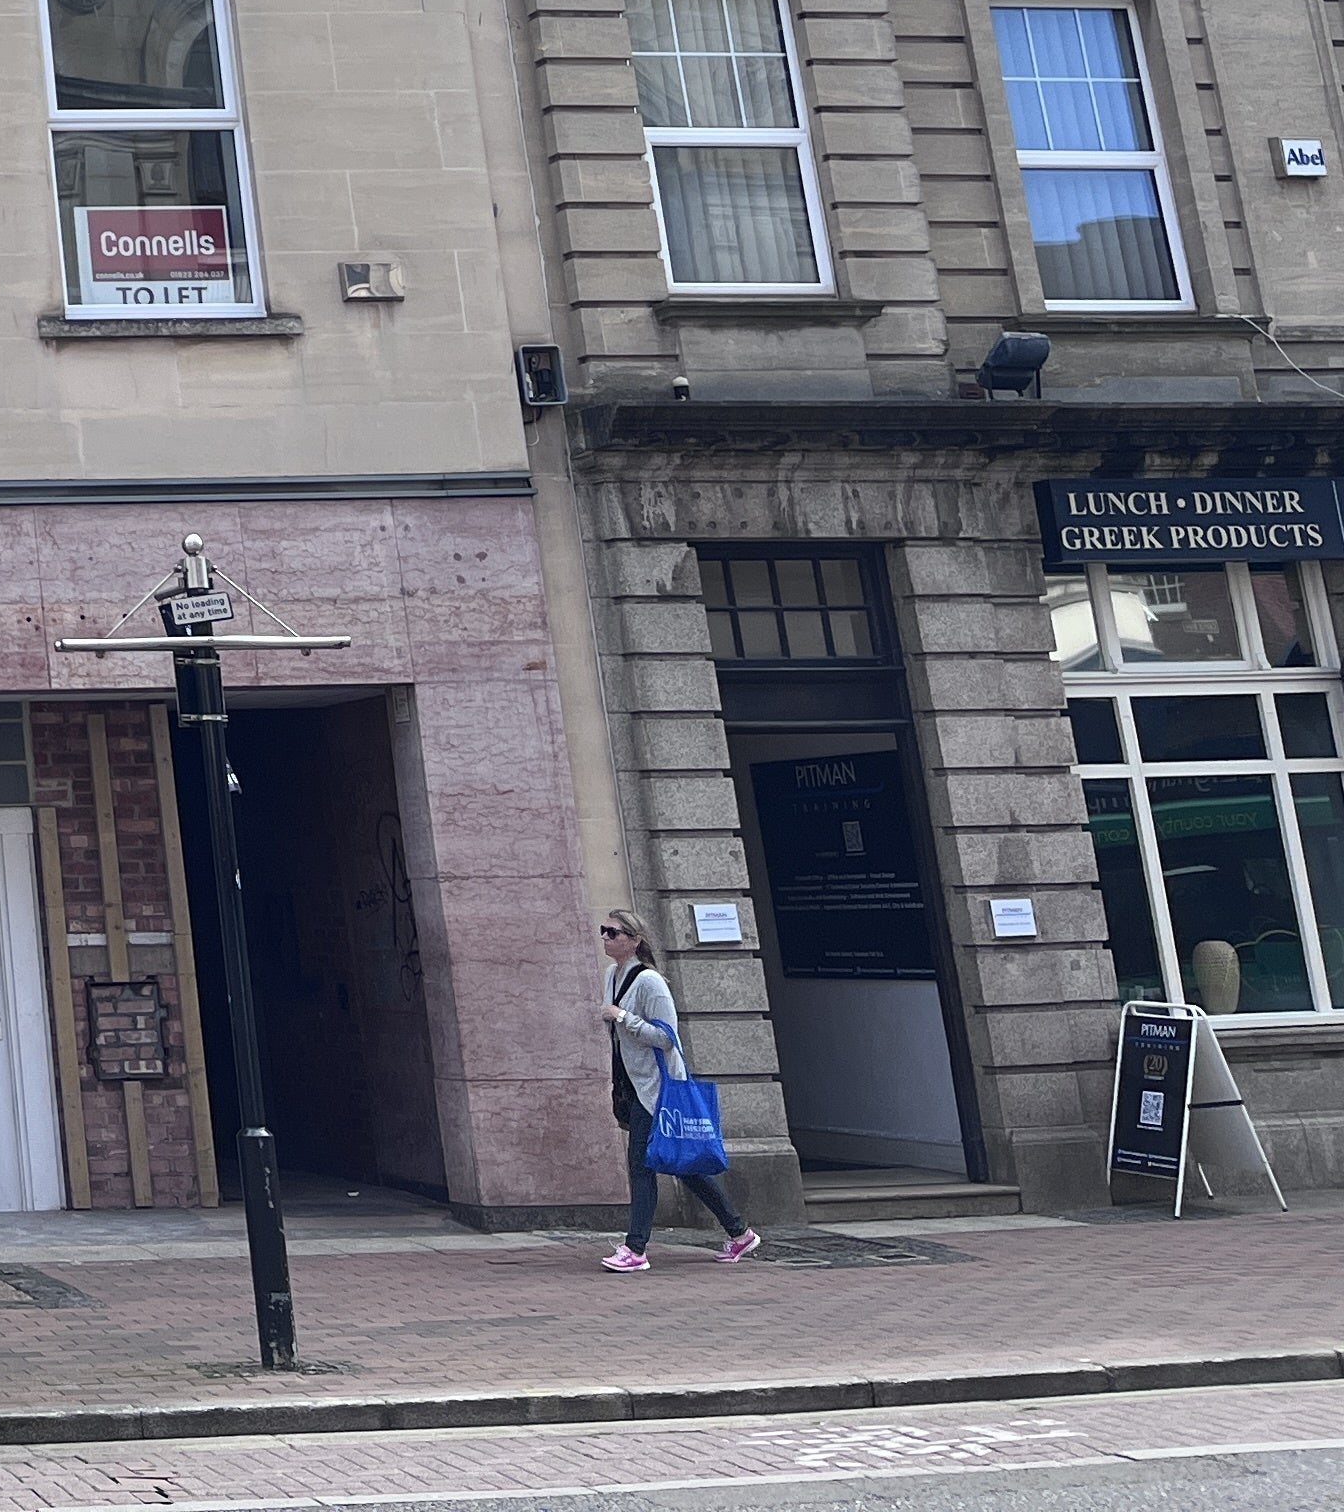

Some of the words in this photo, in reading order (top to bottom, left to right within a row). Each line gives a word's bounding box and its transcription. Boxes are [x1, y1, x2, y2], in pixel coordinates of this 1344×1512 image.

[1288, 148, 1324, 166] Abel
[100, 230, 215, 257] Connells
[1068, 491, 1171, 516] LUNCH
[1193, 490, 1305, 515] DINNER
[1061, 526, 1164, 550] GREEK
[1169, 523, 1323, 549] PRODUCTS
[176, 602, 189, 610] No
[192, 598, 225, 608] loading
[208, 607, 228, 616] time
[795, 761, 856, 788] PITMAN
[1141, 1023, 1176, 1038] PITMAN
